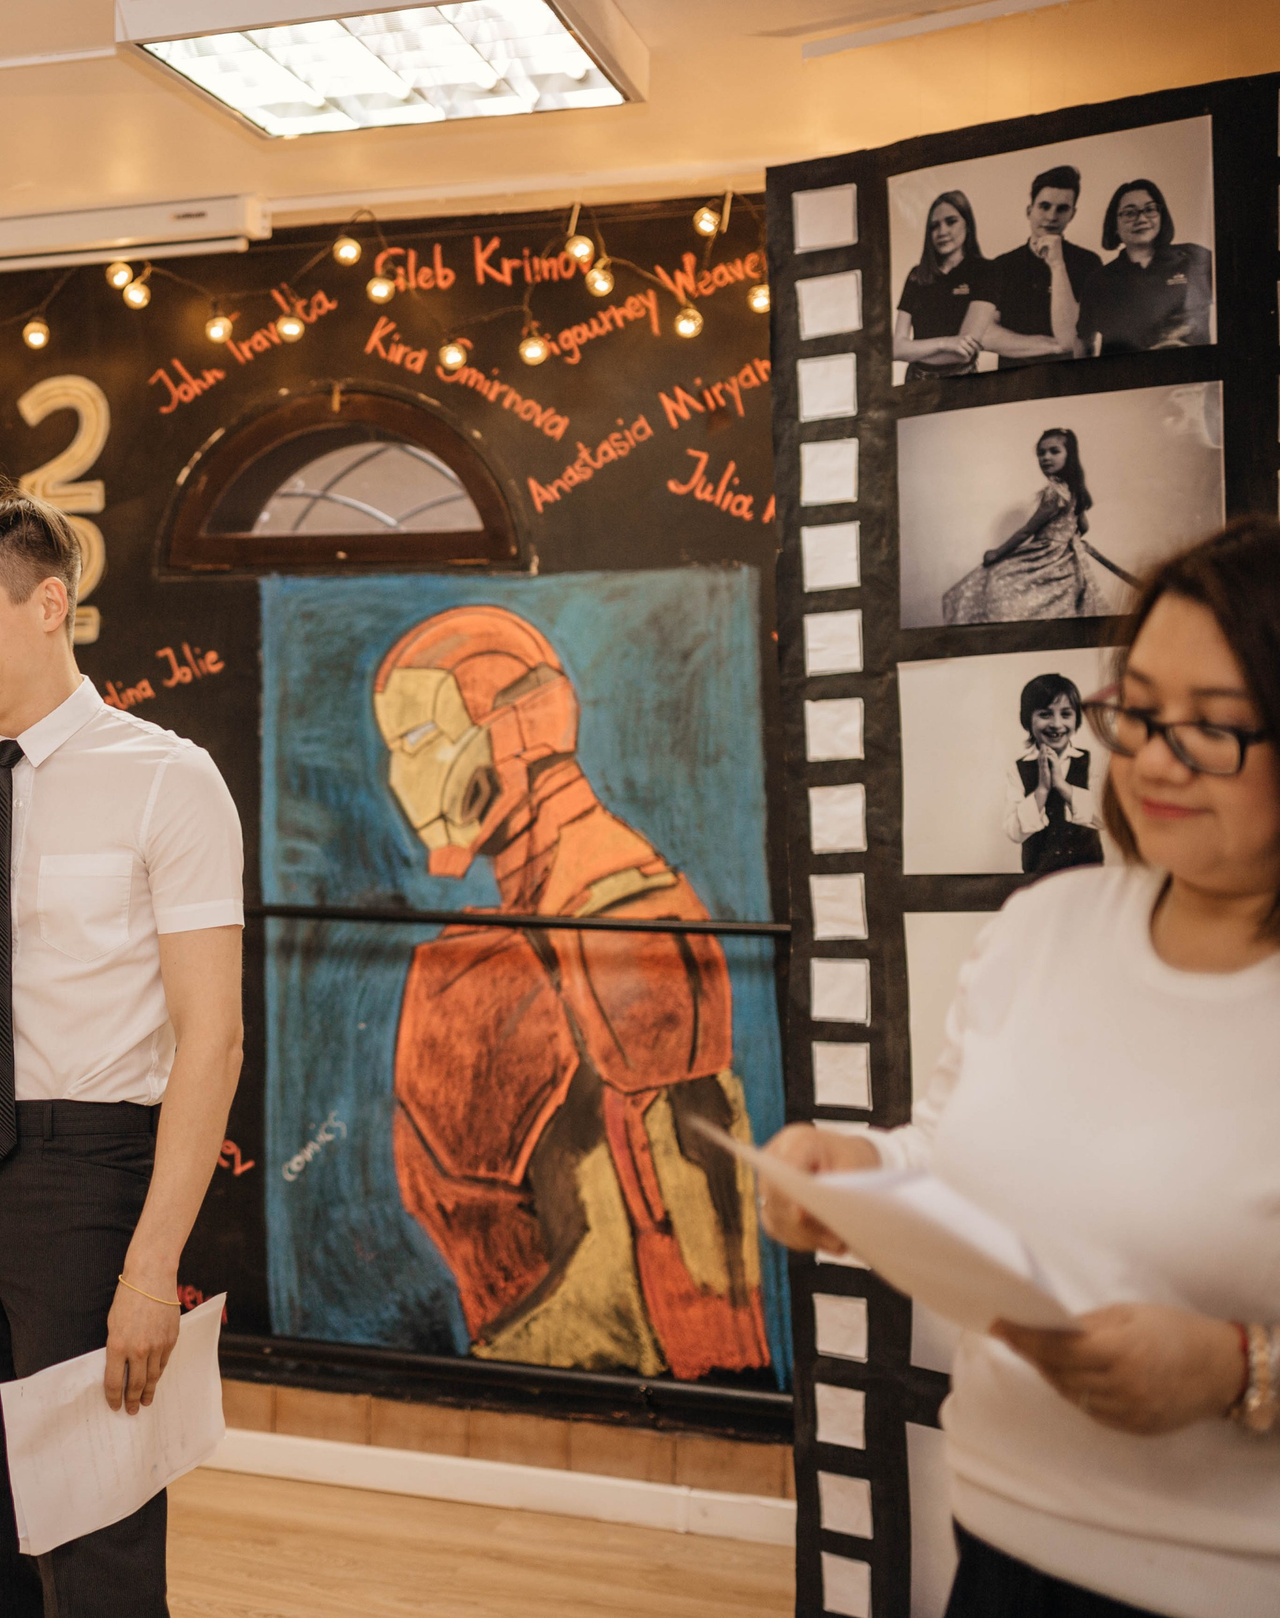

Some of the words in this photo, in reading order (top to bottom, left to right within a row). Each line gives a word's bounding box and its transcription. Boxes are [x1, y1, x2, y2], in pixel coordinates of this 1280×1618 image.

[148, 357, 226, 414] John
[223, 281, 338, 364] Travlta
[364, 315, 428, 374] Kira
[522, 288, 661, 365] igourney
[654, 251, 768, 299] Weave
[527, 414, 654, 514] Anastasia
[667, 448, 754, 521] Julia
[155, 641, 225, 688] Jolie
